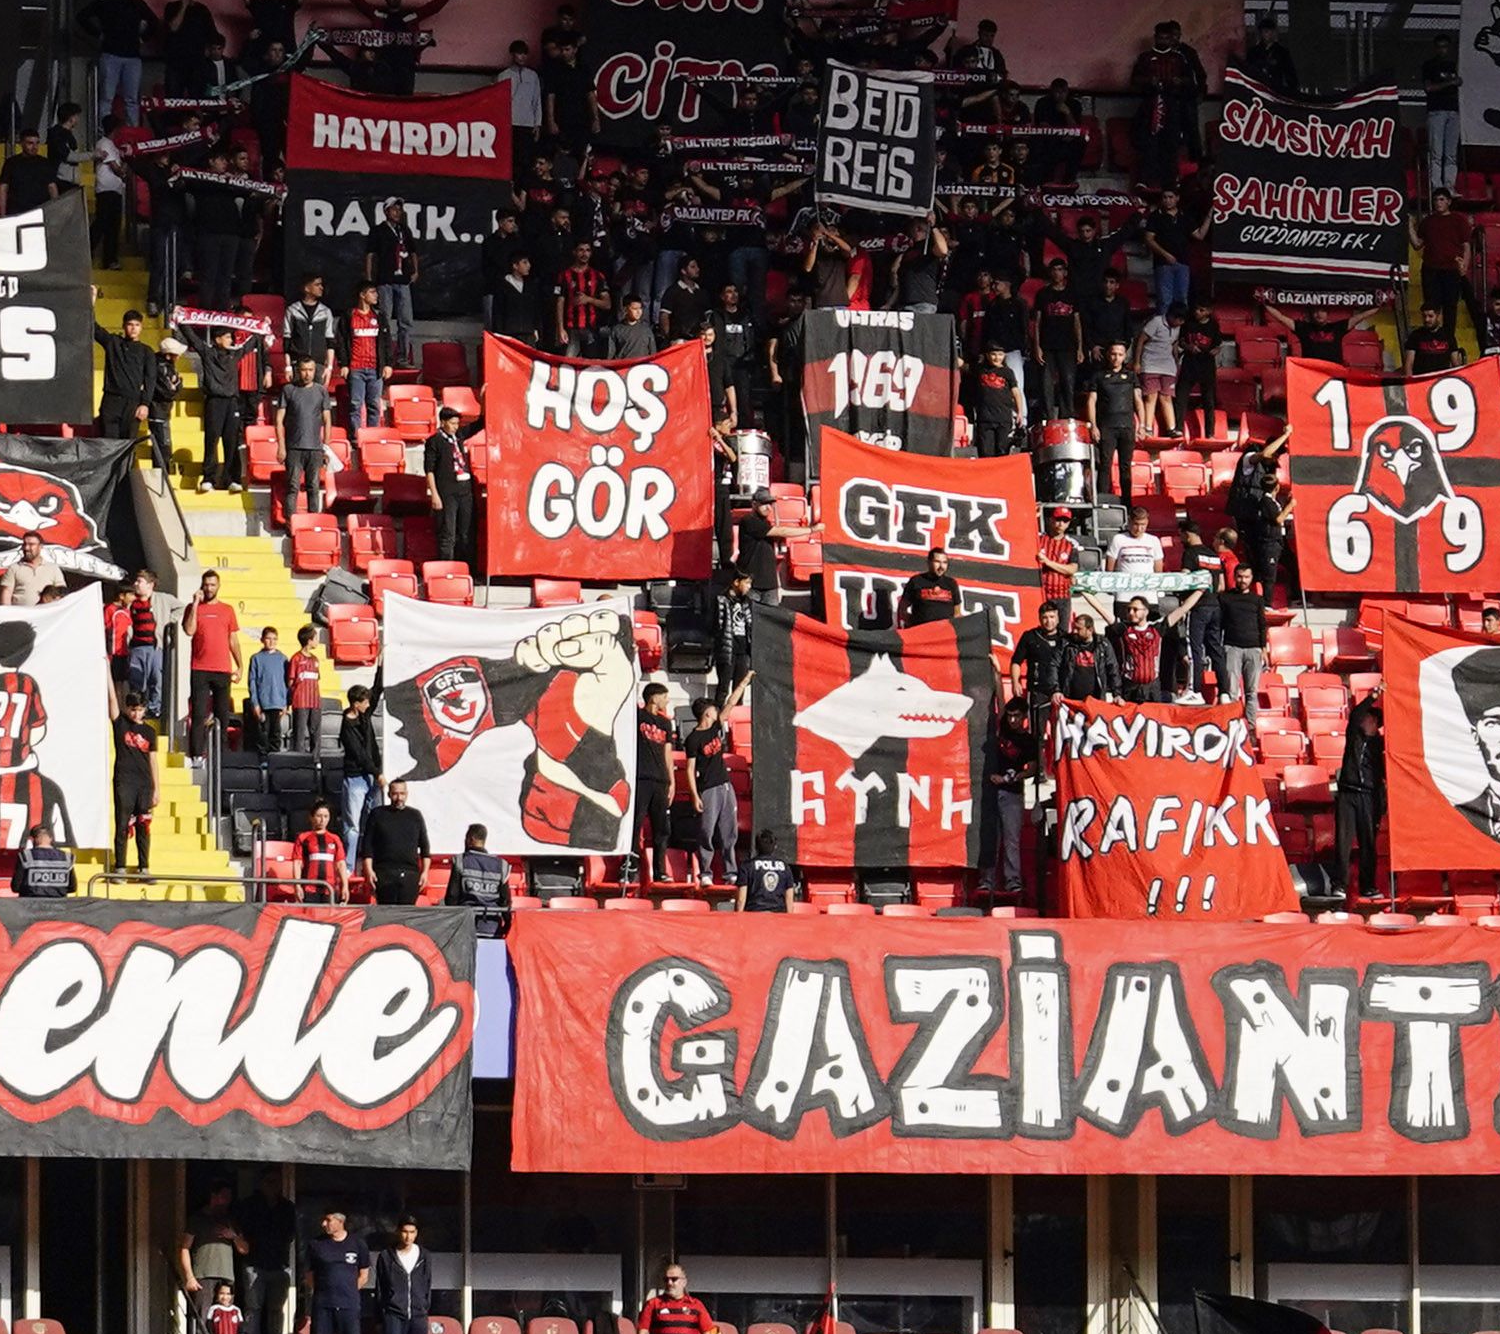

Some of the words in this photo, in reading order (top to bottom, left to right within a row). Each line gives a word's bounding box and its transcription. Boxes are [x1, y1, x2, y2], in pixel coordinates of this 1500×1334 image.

[313, 112, 497, 159] HAYIRDIR
[1220, 97, 1394, 160] SİMSİYAH
[1214, 172, 1402, 225] ŞAHİNLER
[526, 360, 671, 454] HOŞ
[528, 443, 675, 542] GÖR
[839, 476, 1009, 560] GFK
[436, 670, 466, 689] GFK
[1061, 795, 1280, 860] RAFIKK
[1146, 875, 1217, 916] !!!
